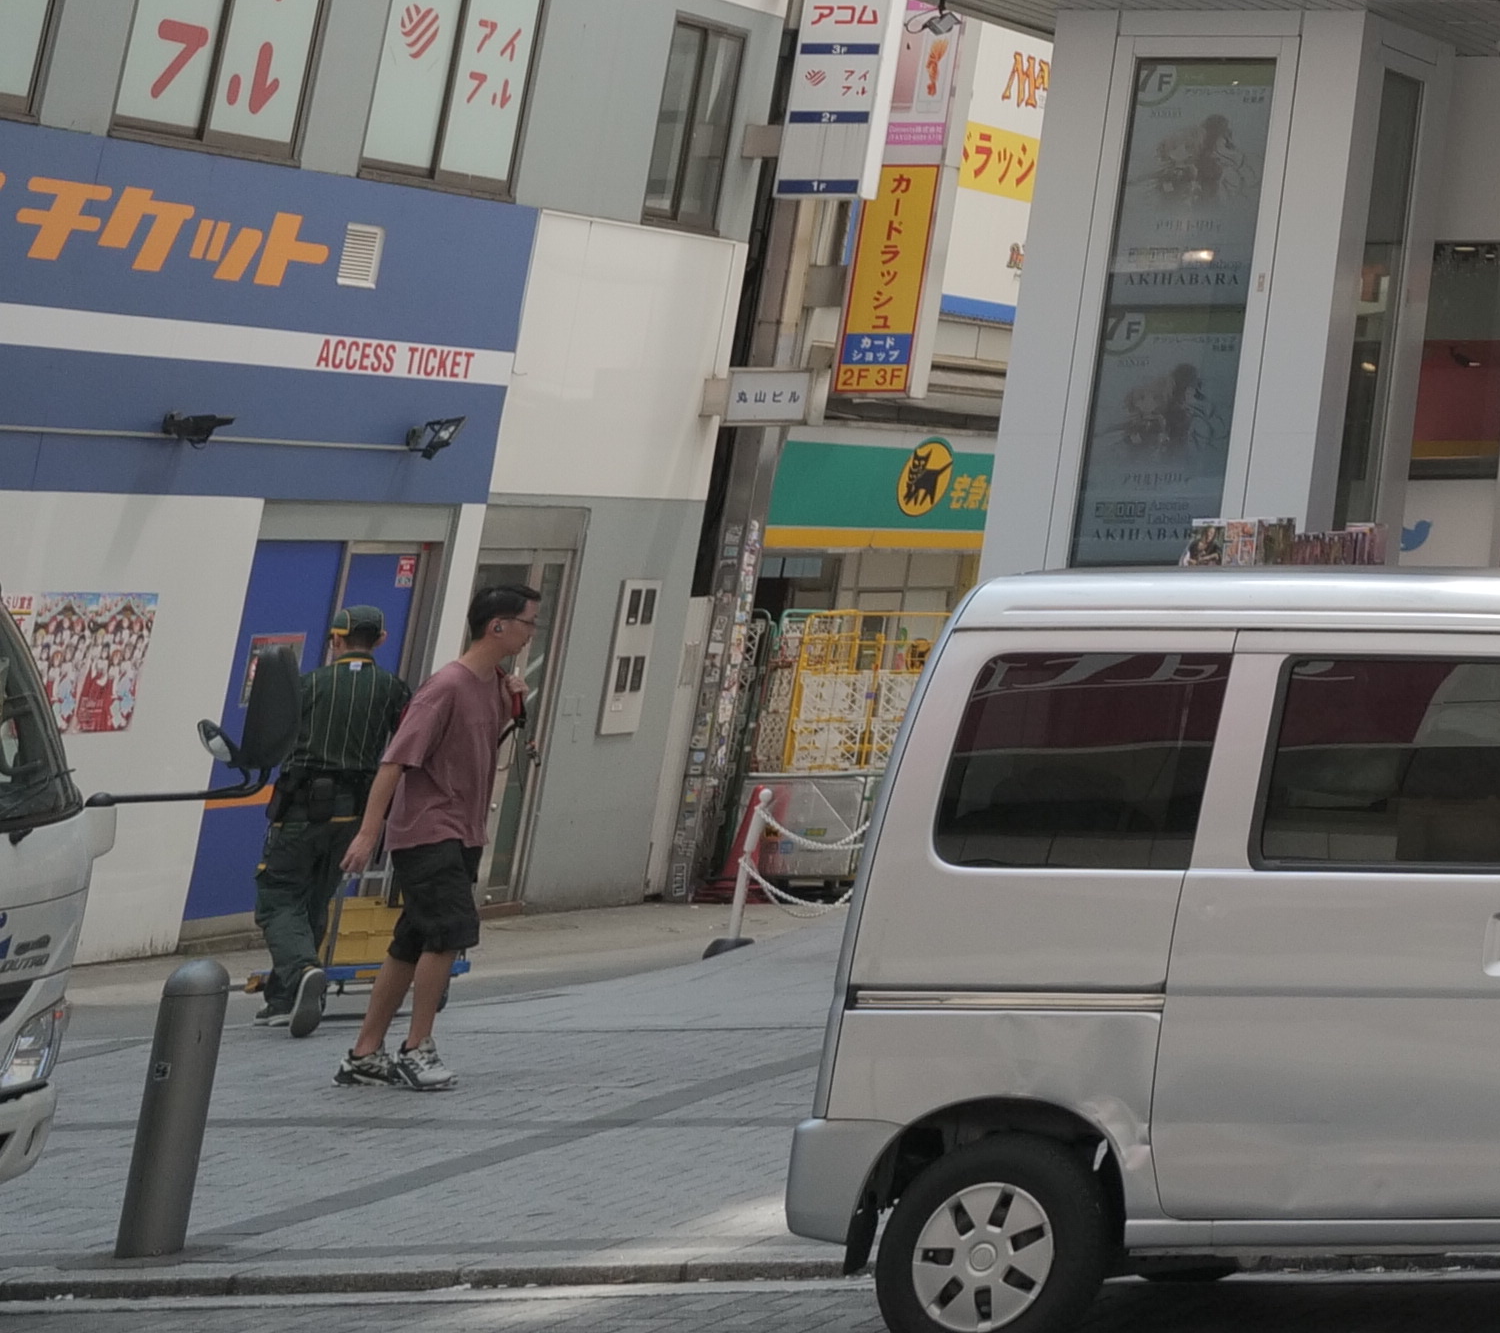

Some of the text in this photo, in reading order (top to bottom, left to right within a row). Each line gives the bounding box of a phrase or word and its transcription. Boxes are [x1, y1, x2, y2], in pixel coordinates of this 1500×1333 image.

[810, 4, 879, 26] アコム
[831, 45, 848, 54] 3F
[820, 112, 838, 123] 2F
[810, 180, 828, 192] 1F
[0, 171, 330, 288] チケット
[1125, 272, 1239, 286] AKIHABARA
[860, 335, 896, 350] カード
[316, 338, 476, 380] ACCESS TICKET
[850, 348, 901, 363] ショップ
[841, 367, 902, 388] 2F 3F
[735, 388, 802, 406] 丸山ビル
